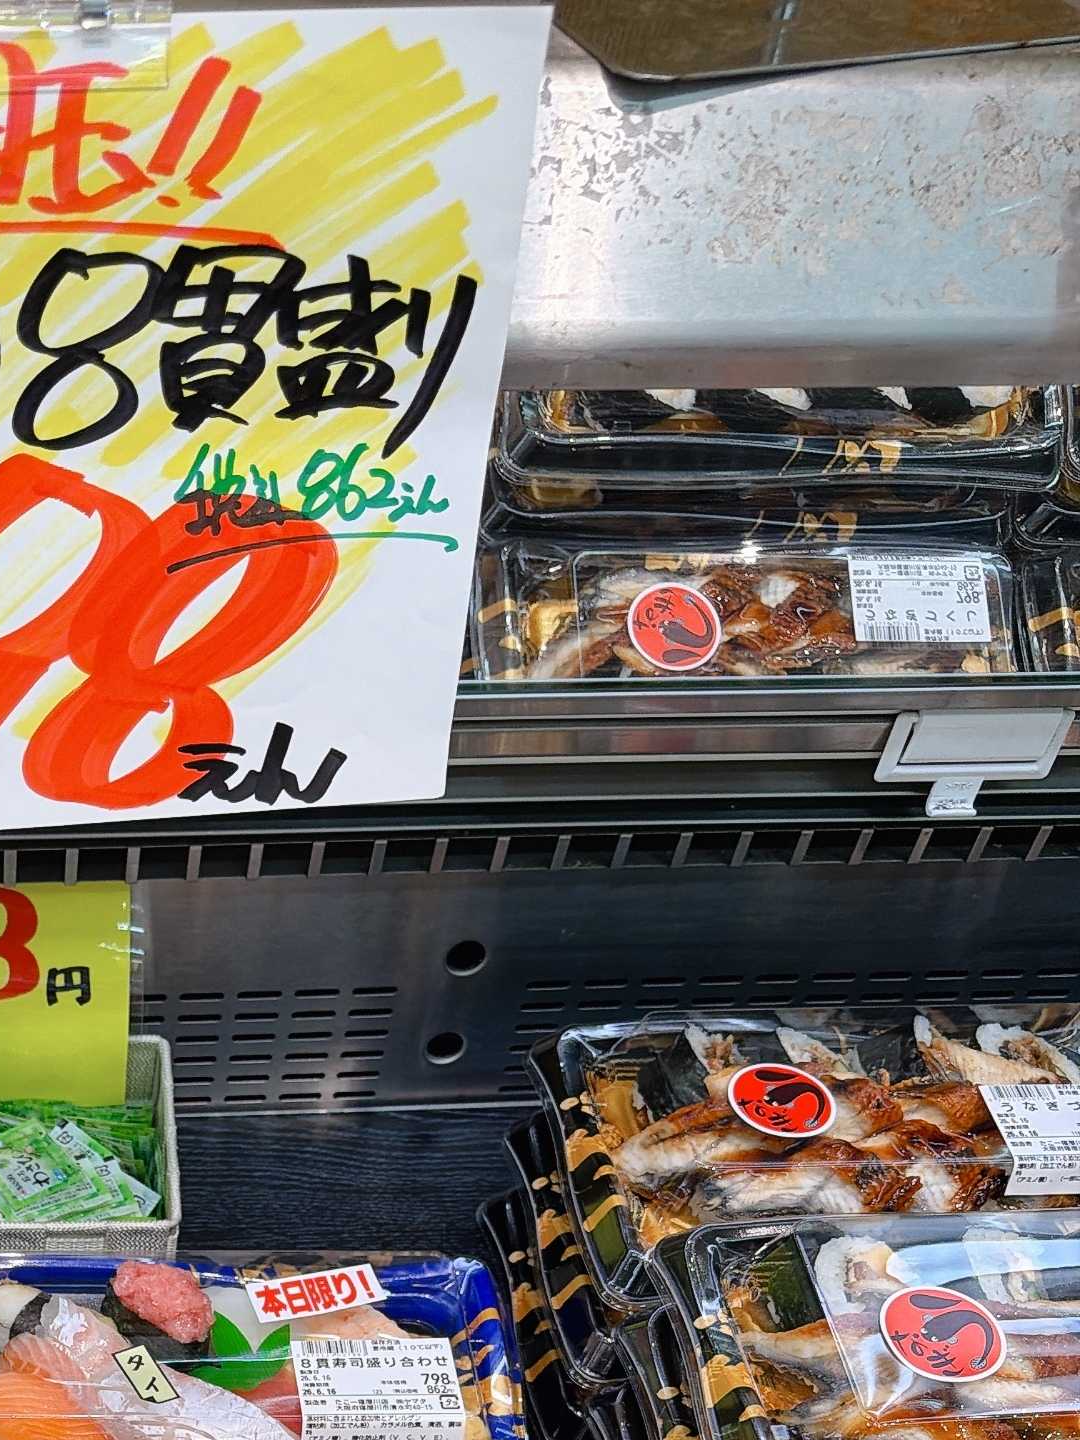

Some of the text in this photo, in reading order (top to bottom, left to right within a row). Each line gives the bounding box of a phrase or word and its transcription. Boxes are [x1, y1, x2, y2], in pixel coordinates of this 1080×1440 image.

[255, 1270, 376, 1318] 本日限り!
[127, 1354, 159, 1397] タイ
[302, 1356, 448, 1369] 8貫寿司盛り合わせ
